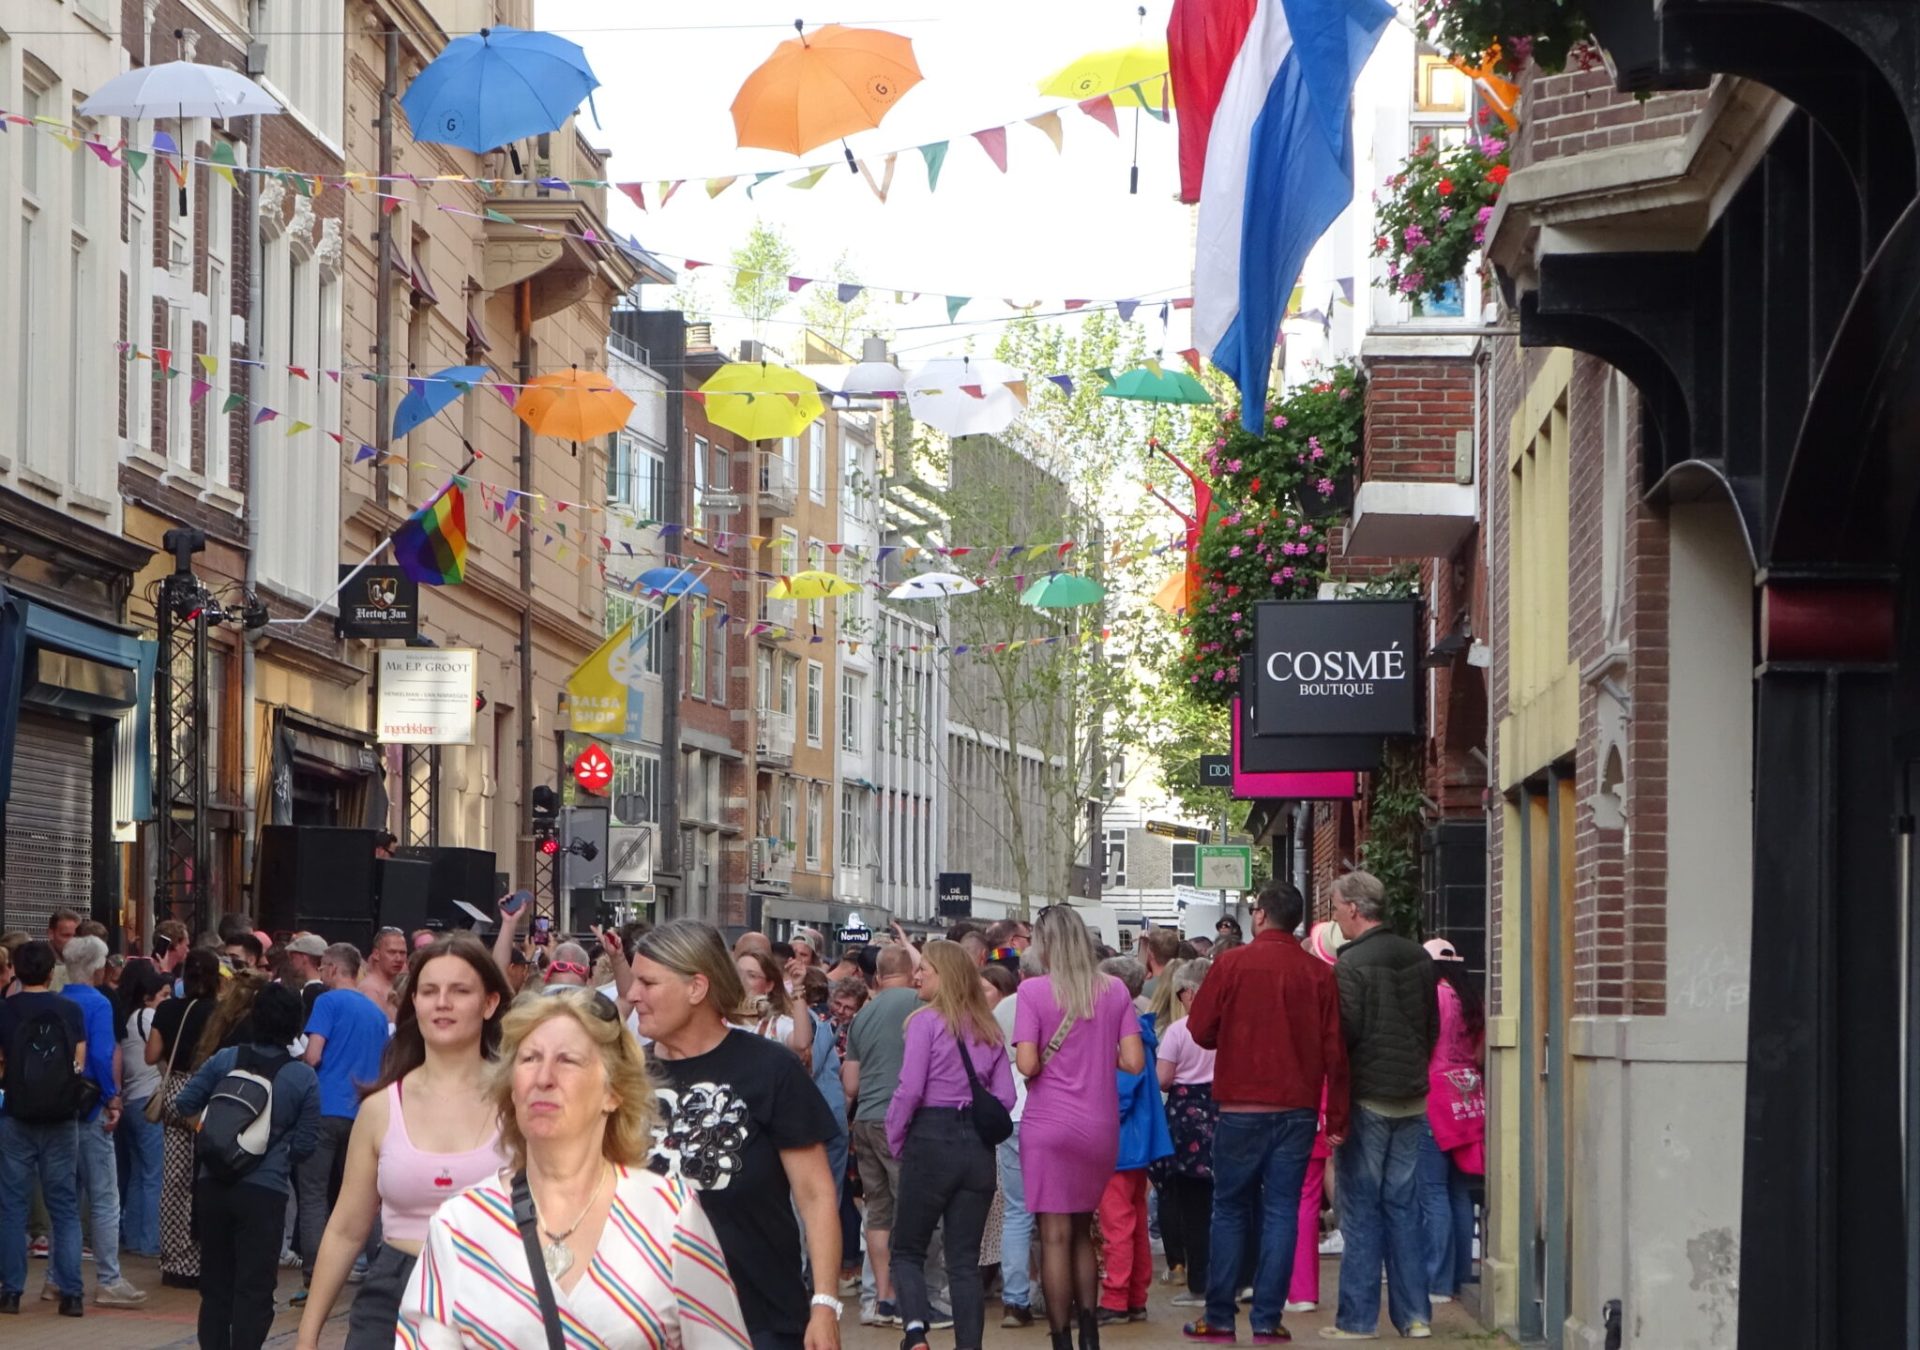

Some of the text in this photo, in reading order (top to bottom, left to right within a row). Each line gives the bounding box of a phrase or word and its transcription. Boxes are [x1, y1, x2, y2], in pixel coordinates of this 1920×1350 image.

[875, 82, 889, 96] G
[1080, 79, 1092, 90] G
[446, 118, 456, 132] G
[355, 608, 407, 621] Hertog Jan
[425, 662, 470, 673] GROOT
[1266, 641, 1406, 682] COSMÉ
[1299, 683, 1375, 698] BOUTIQUE
[571, 695, 620, 709] SALSA
[576, 711, 616, 723] SHOP
[840, 931, 869, 941] Normal
